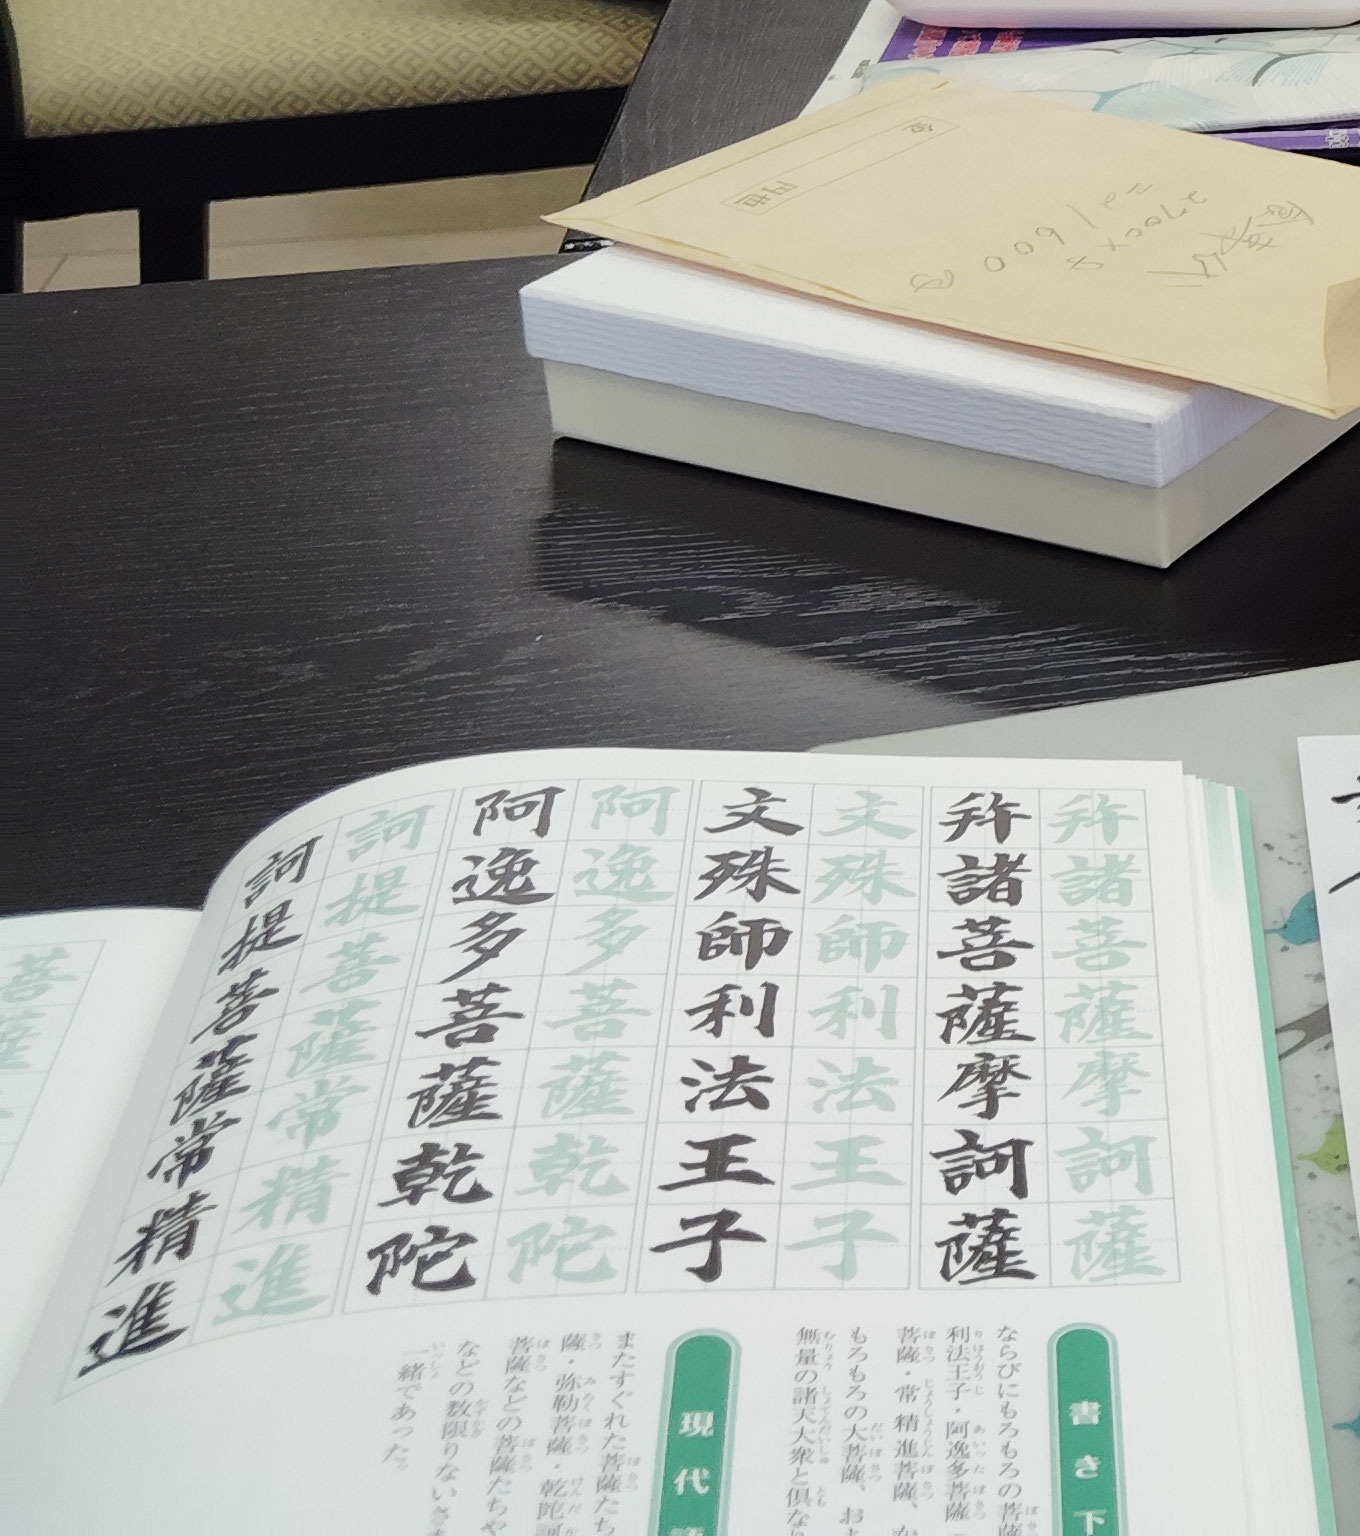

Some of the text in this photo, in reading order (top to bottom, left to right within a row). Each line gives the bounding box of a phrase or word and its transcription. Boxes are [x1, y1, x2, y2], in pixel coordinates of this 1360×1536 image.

[76, 835, 324, 1380] 訶提菩薩常精進
[211, 802, 436, 1325] 訶提菩薩常精進
[365, 786, 566, 1296] 阿逸多菩薩乾陀
[505, 784, 682, 1285] 阿逸多菩薩乾陀
[649, 787, 805, 1284] 文殊師利法王子
[785, 790, 917, 1284] 文殊師利法王子
